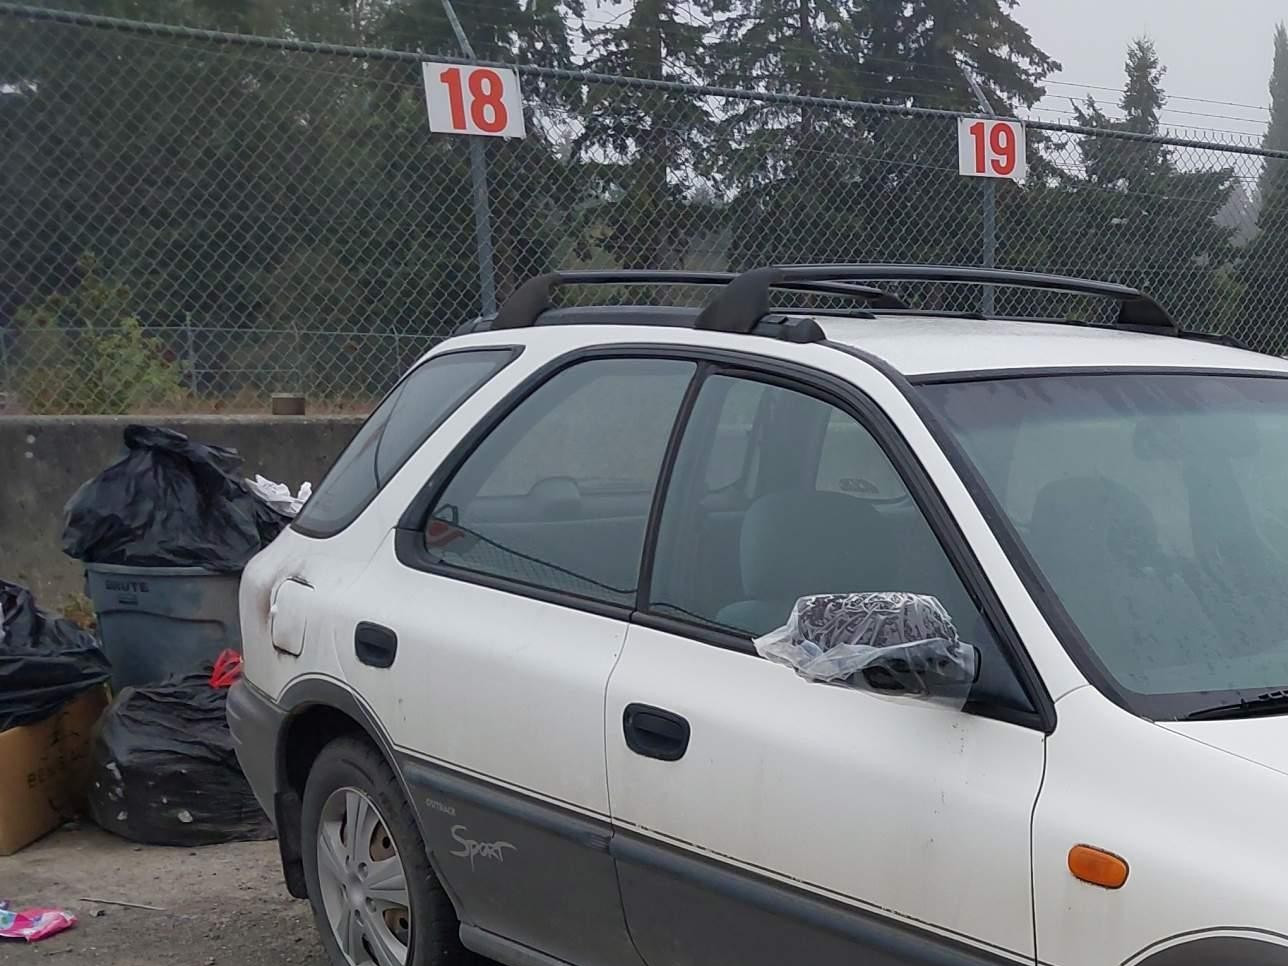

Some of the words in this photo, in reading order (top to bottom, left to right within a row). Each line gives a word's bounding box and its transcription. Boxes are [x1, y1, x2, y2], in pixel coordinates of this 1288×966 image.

[440, 68, 508, 134] 18
[969, 122, 1016, 176] 19
[105, 580, 149, 593] BRUTE
